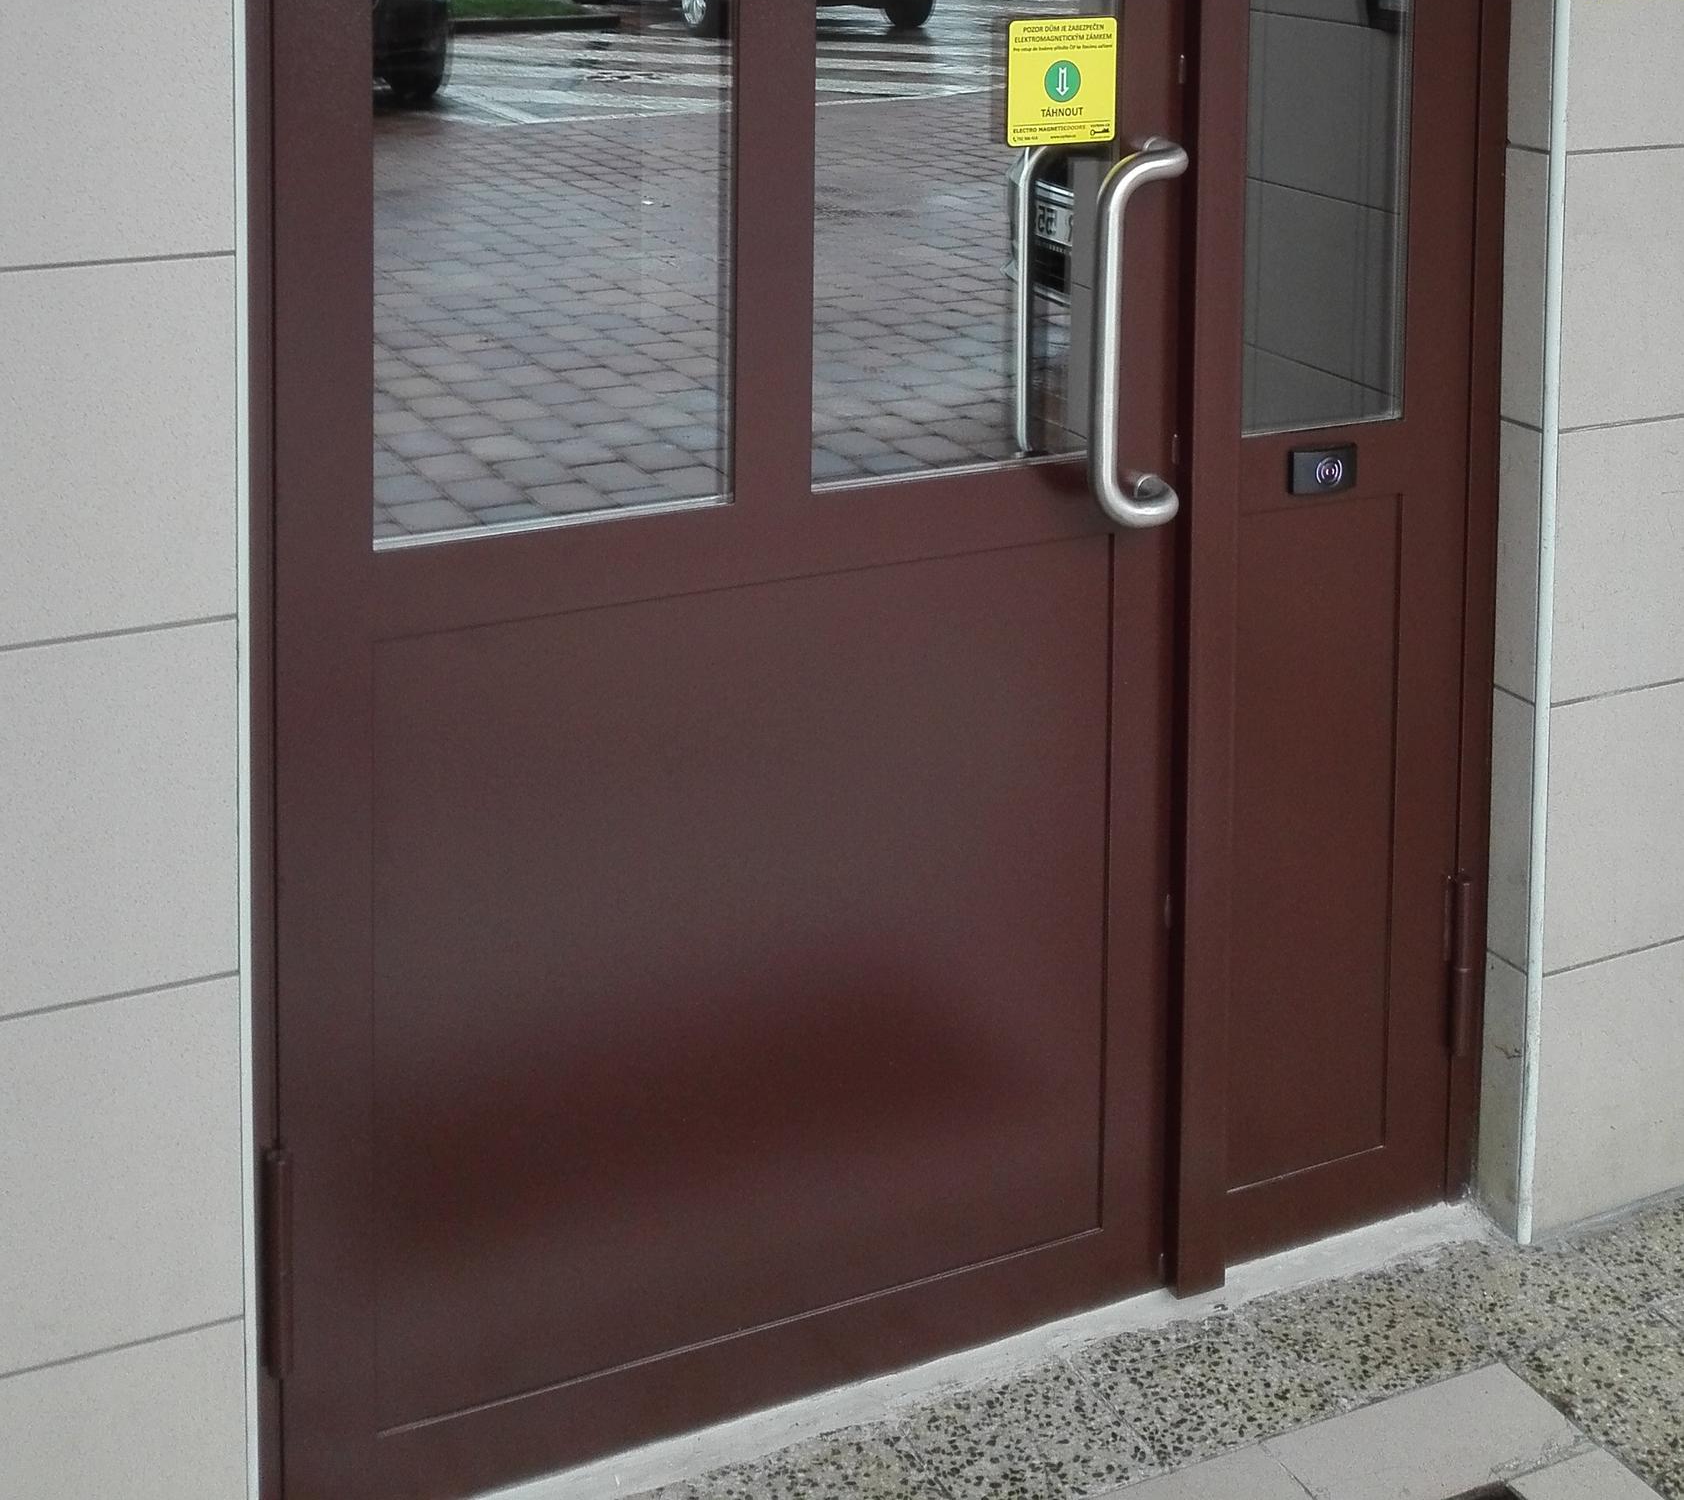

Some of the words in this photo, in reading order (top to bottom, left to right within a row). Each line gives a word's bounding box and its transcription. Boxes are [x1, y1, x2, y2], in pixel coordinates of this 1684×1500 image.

[1023, 26, 1045, 34] POZOR
[1044, 24, 1060, 33] DŮM
[1068, 23, 1105, 32] ZABEZPEČEN
[1014, 33, 1085, 44] ELEKTROMAGNETICKÝM
[1085, 32, 1113, 41] ZÁMKEM
[1041, 106, 1084, 118] TÁHNOUT
